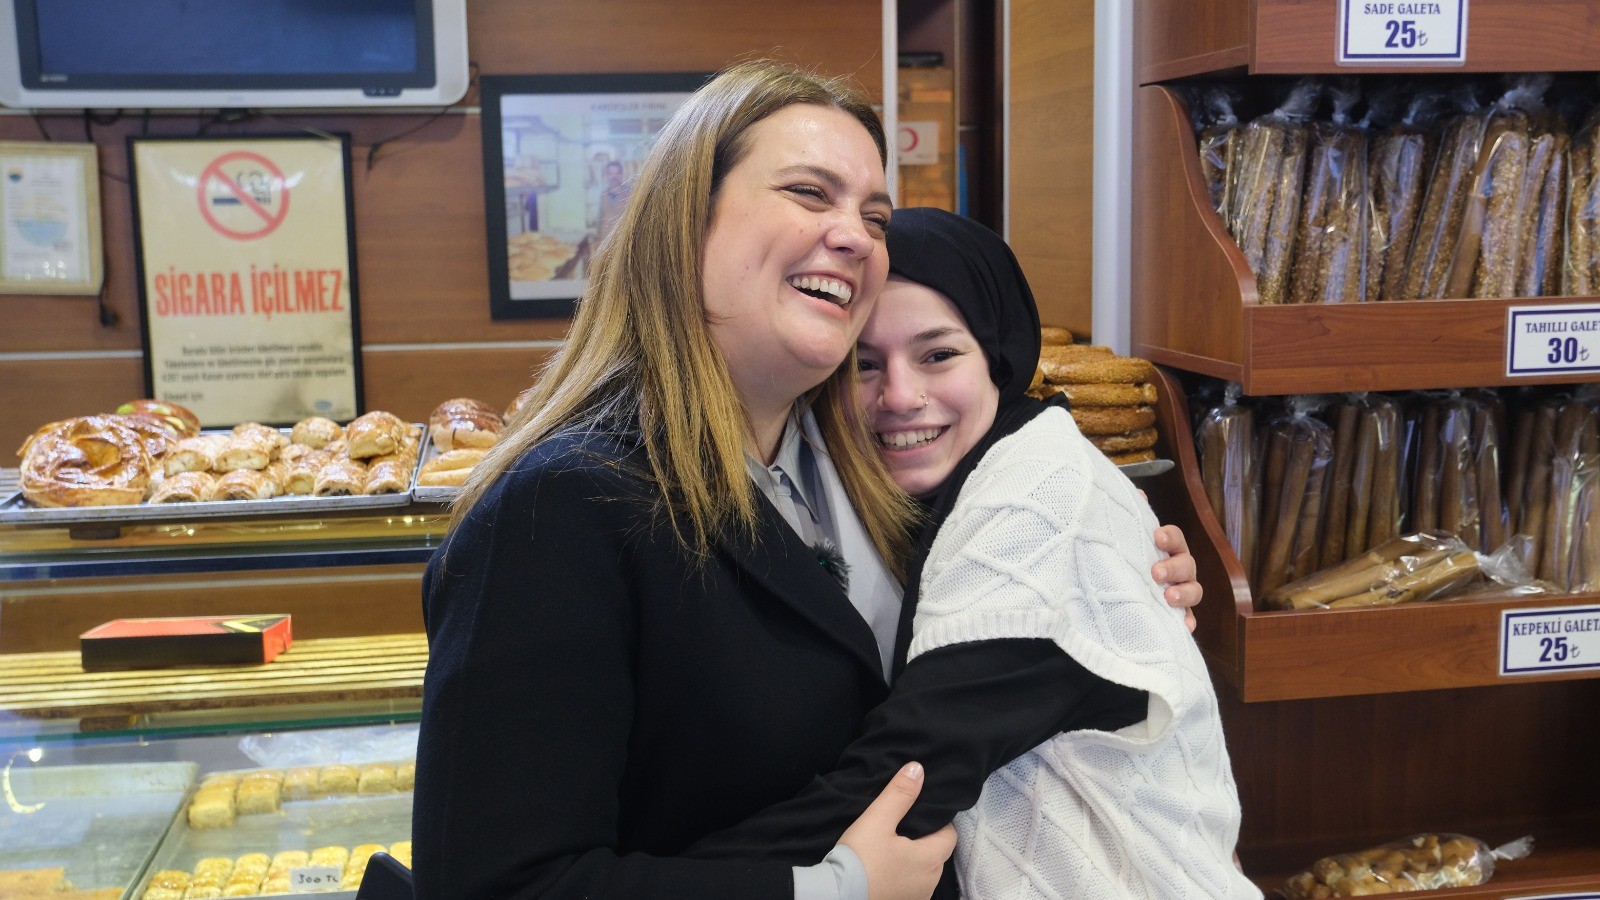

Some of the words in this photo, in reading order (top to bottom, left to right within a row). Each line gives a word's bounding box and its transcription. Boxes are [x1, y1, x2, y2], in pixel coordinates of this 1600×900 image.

[1363, 3, 1394, 15] SADE
[1397, 3, 1442, 15] GALETA
[154, 265, 246, 317] SİGARA
[250, 262, 345, 322] İÇİLMEZ
[1525, 321, 1568, 334] TAHILLI
[1570, 320, 1600, 332] GALE
[1513, 617, 1562, 636] KEPEKLİ
[1564, 618, 1600, 633] GALET
[298, 873, 322, 885] 300
